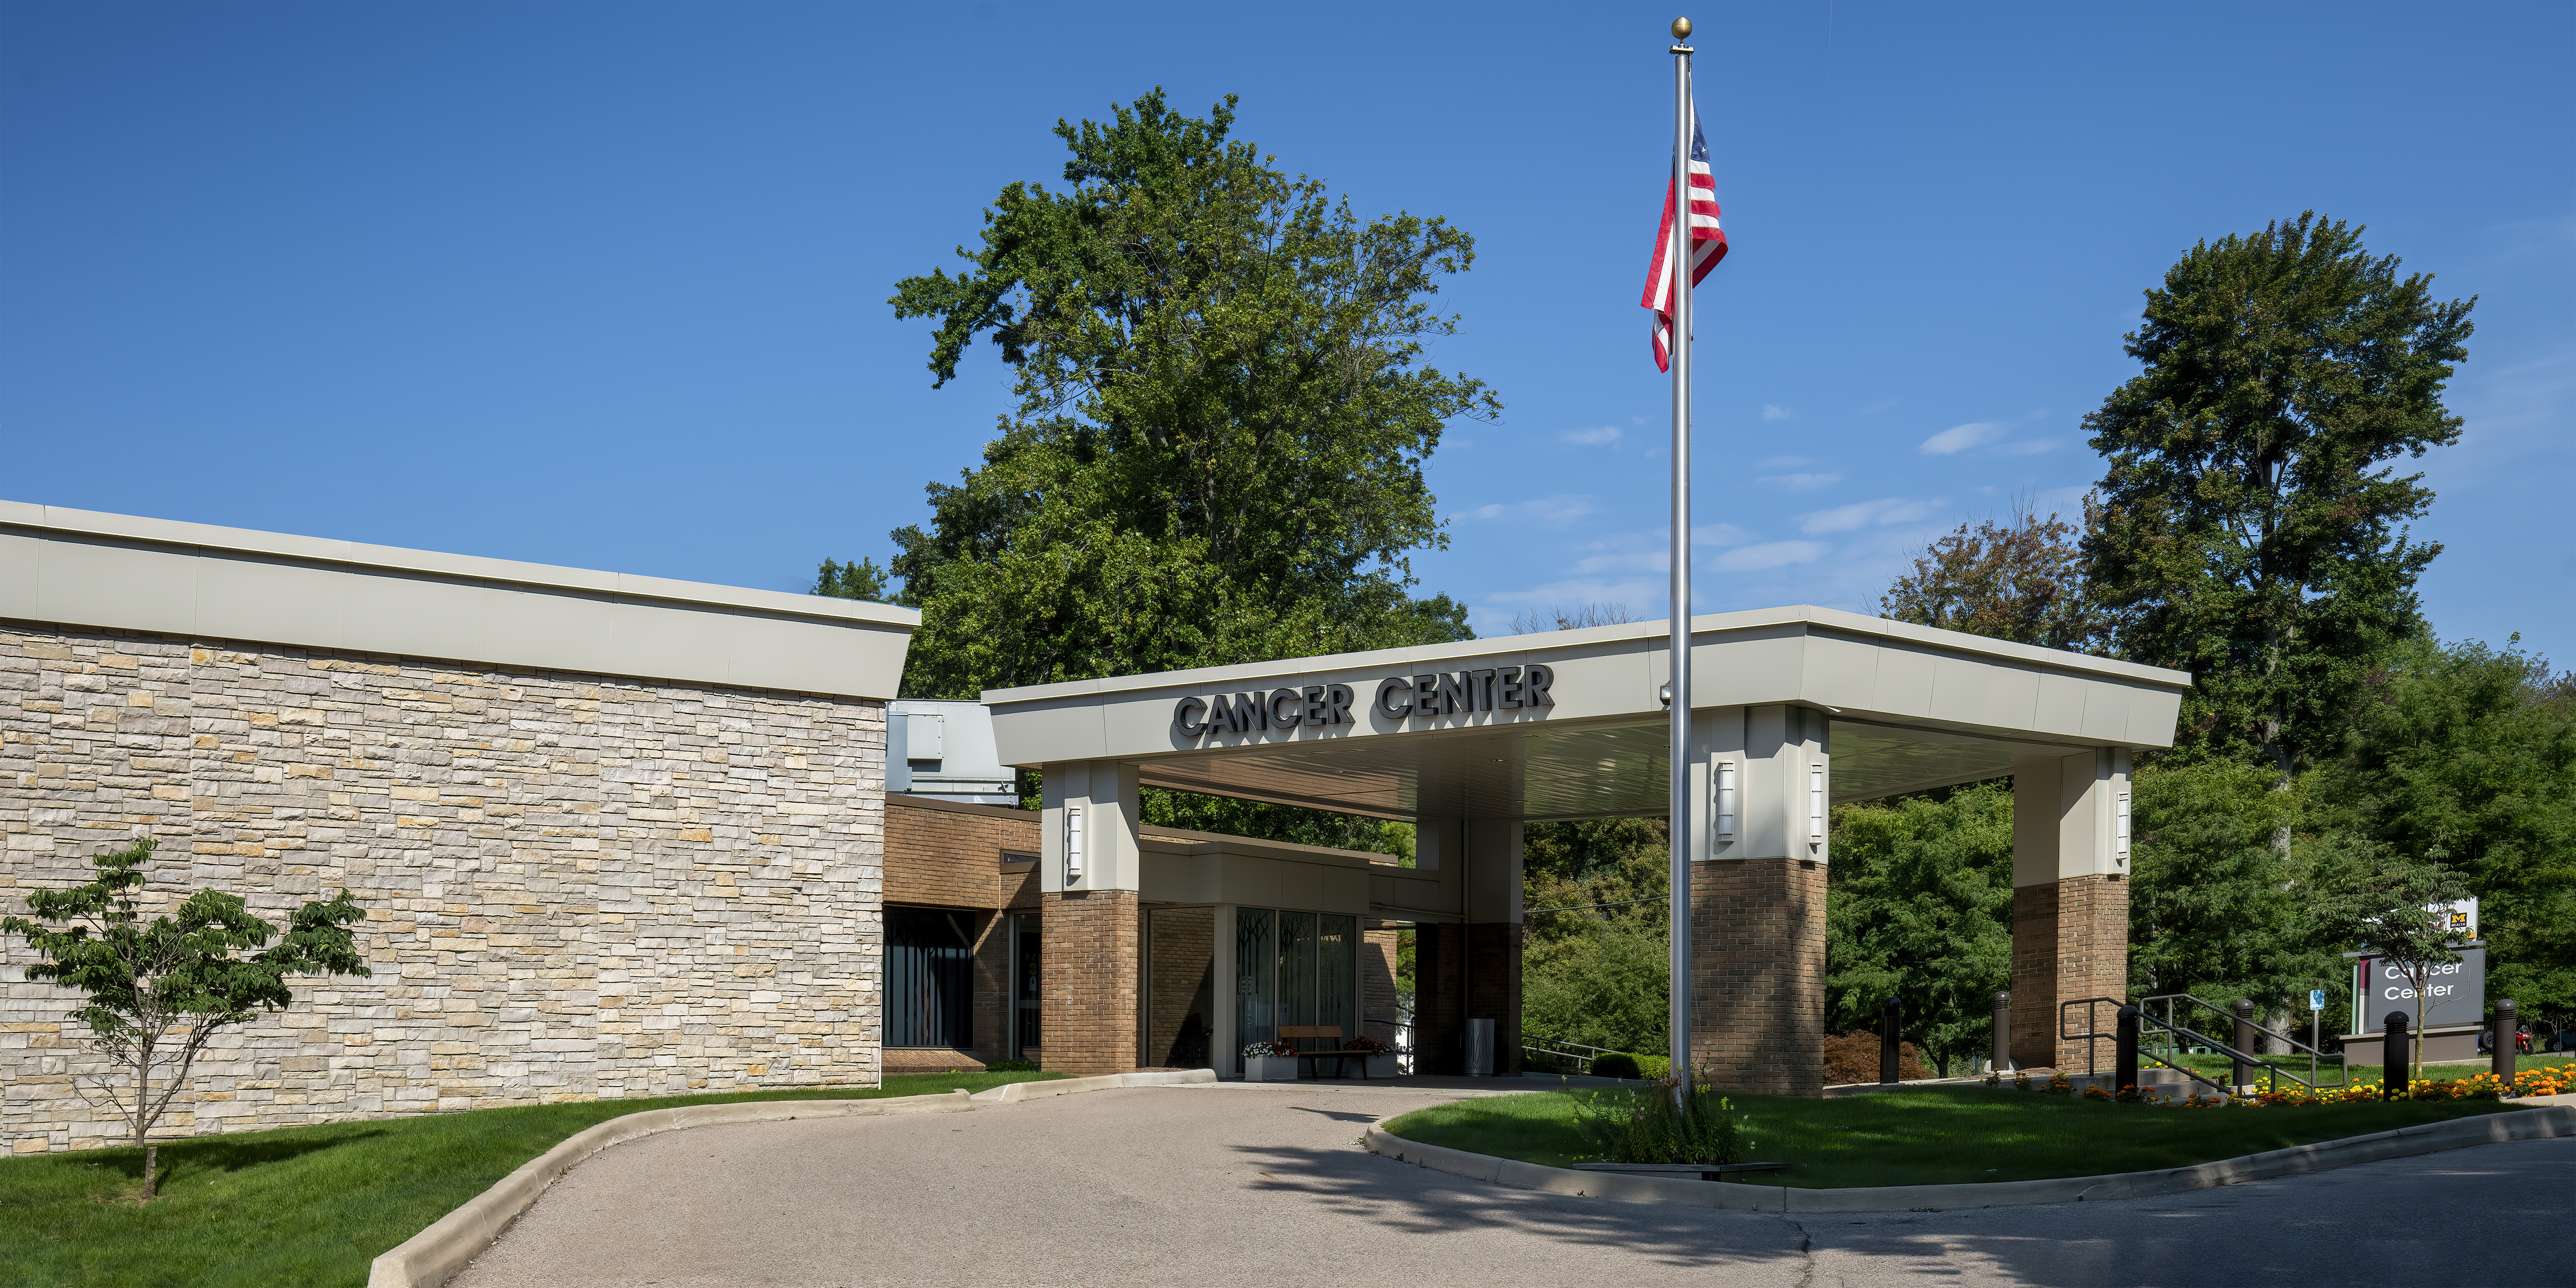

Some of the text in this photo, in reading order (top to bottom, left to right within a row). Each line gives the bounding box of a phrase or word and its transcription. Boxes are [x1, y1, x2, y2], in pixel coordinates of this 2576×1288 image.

[1174, 664, 1555, 737] CANCER CENTER
[2451, 914, 2465, 923] M
